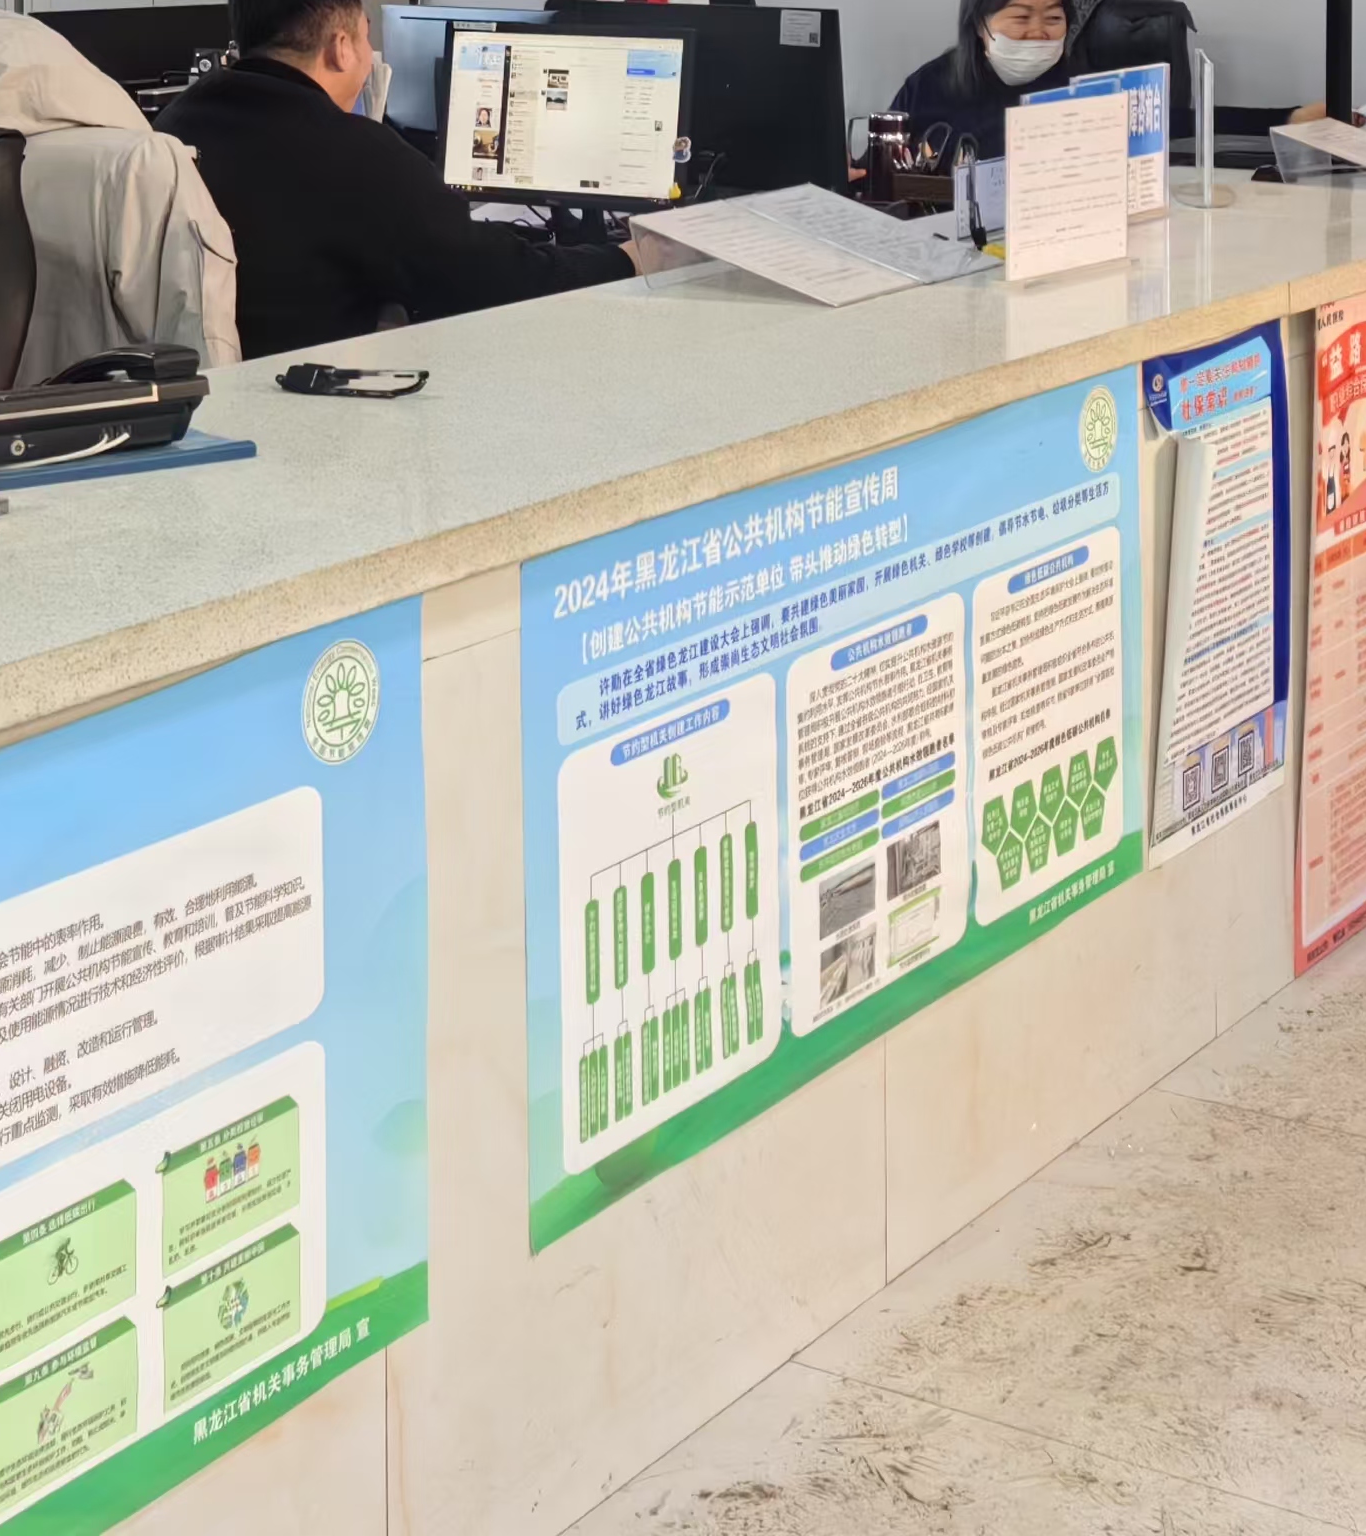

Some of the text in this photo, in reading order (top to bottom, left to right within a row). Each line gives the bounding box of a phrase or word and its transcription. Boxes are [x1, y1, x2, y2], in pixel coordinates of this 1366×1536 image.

[553, 465, 898, 622] 2024年黑龙江省公共机构节能宣传周
[622, 703, 720, 761] 节约型机关创建工作内容
[193, 1323, 351, 1448] 黑龙江省机关事务管理局
[356, 1314, 370, 1344] 宣
